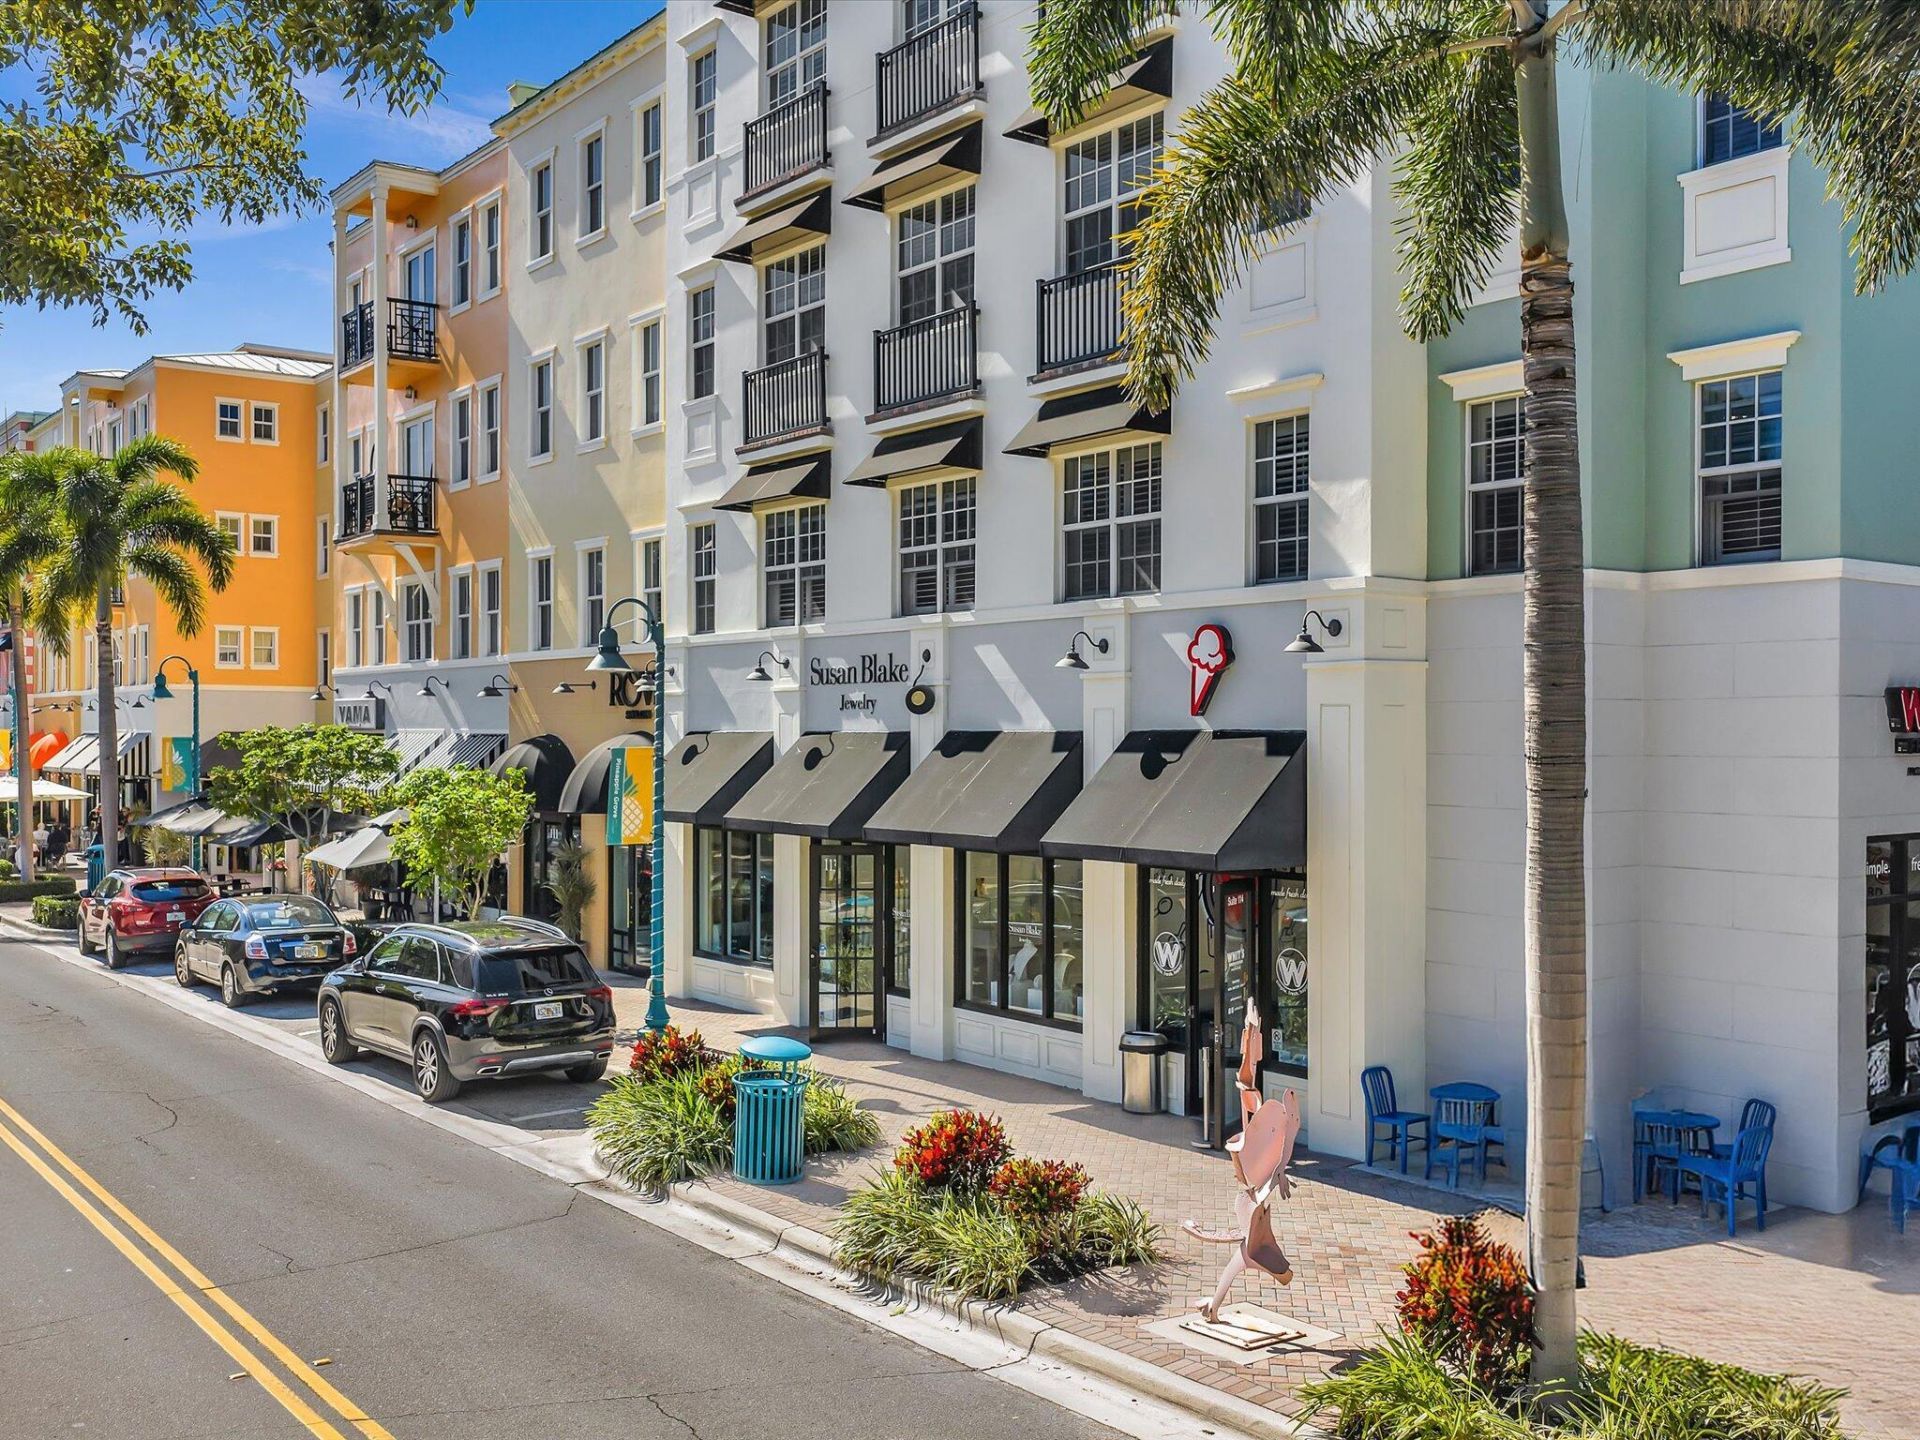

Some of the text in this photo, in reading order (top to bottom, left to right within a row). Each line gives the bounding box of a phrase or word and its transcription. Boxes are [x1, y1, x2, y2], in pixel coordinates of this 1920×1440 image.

[810, 652, 909, 686] Susan Blake
[339, 705, 371, 723] YAMA
[839, 693, 877, 715] Jewelry
[612, 758, 622, 819] Pineapple Grove
[1866, 859, 1891, 879] imple.
[1155, 941, 1180, 970] W
[1279, 957, 1306, 987] W
